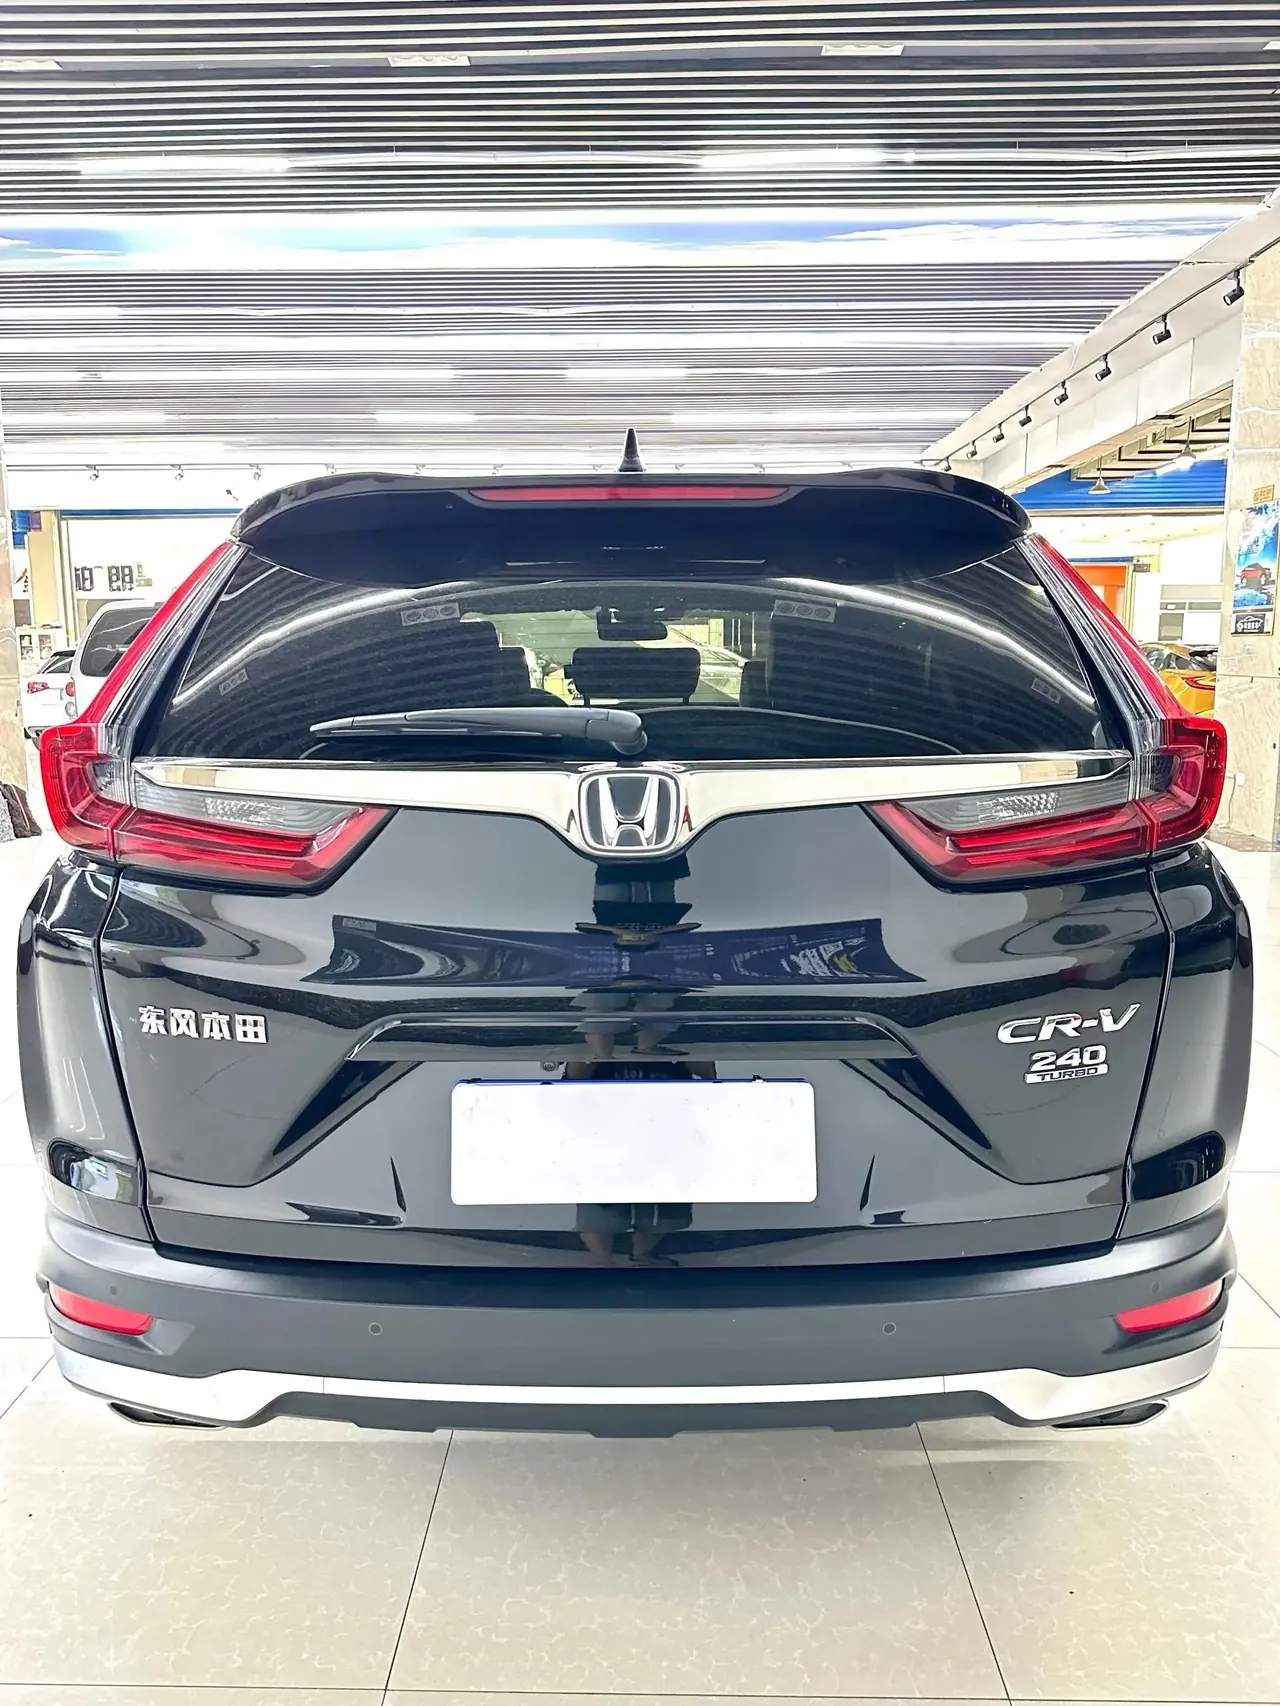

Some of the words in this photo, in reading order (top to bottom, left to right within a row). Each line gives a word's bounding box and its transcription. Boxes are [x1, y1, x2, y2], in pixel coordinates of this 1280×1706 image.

[138, 1005, 268, 1044] 东风本田
[997, 1003, 1141, 1044] CR-V
[1030, 1044, 1107, 1072] 240
[1036, 1066, 1099, 1082] TURBO
